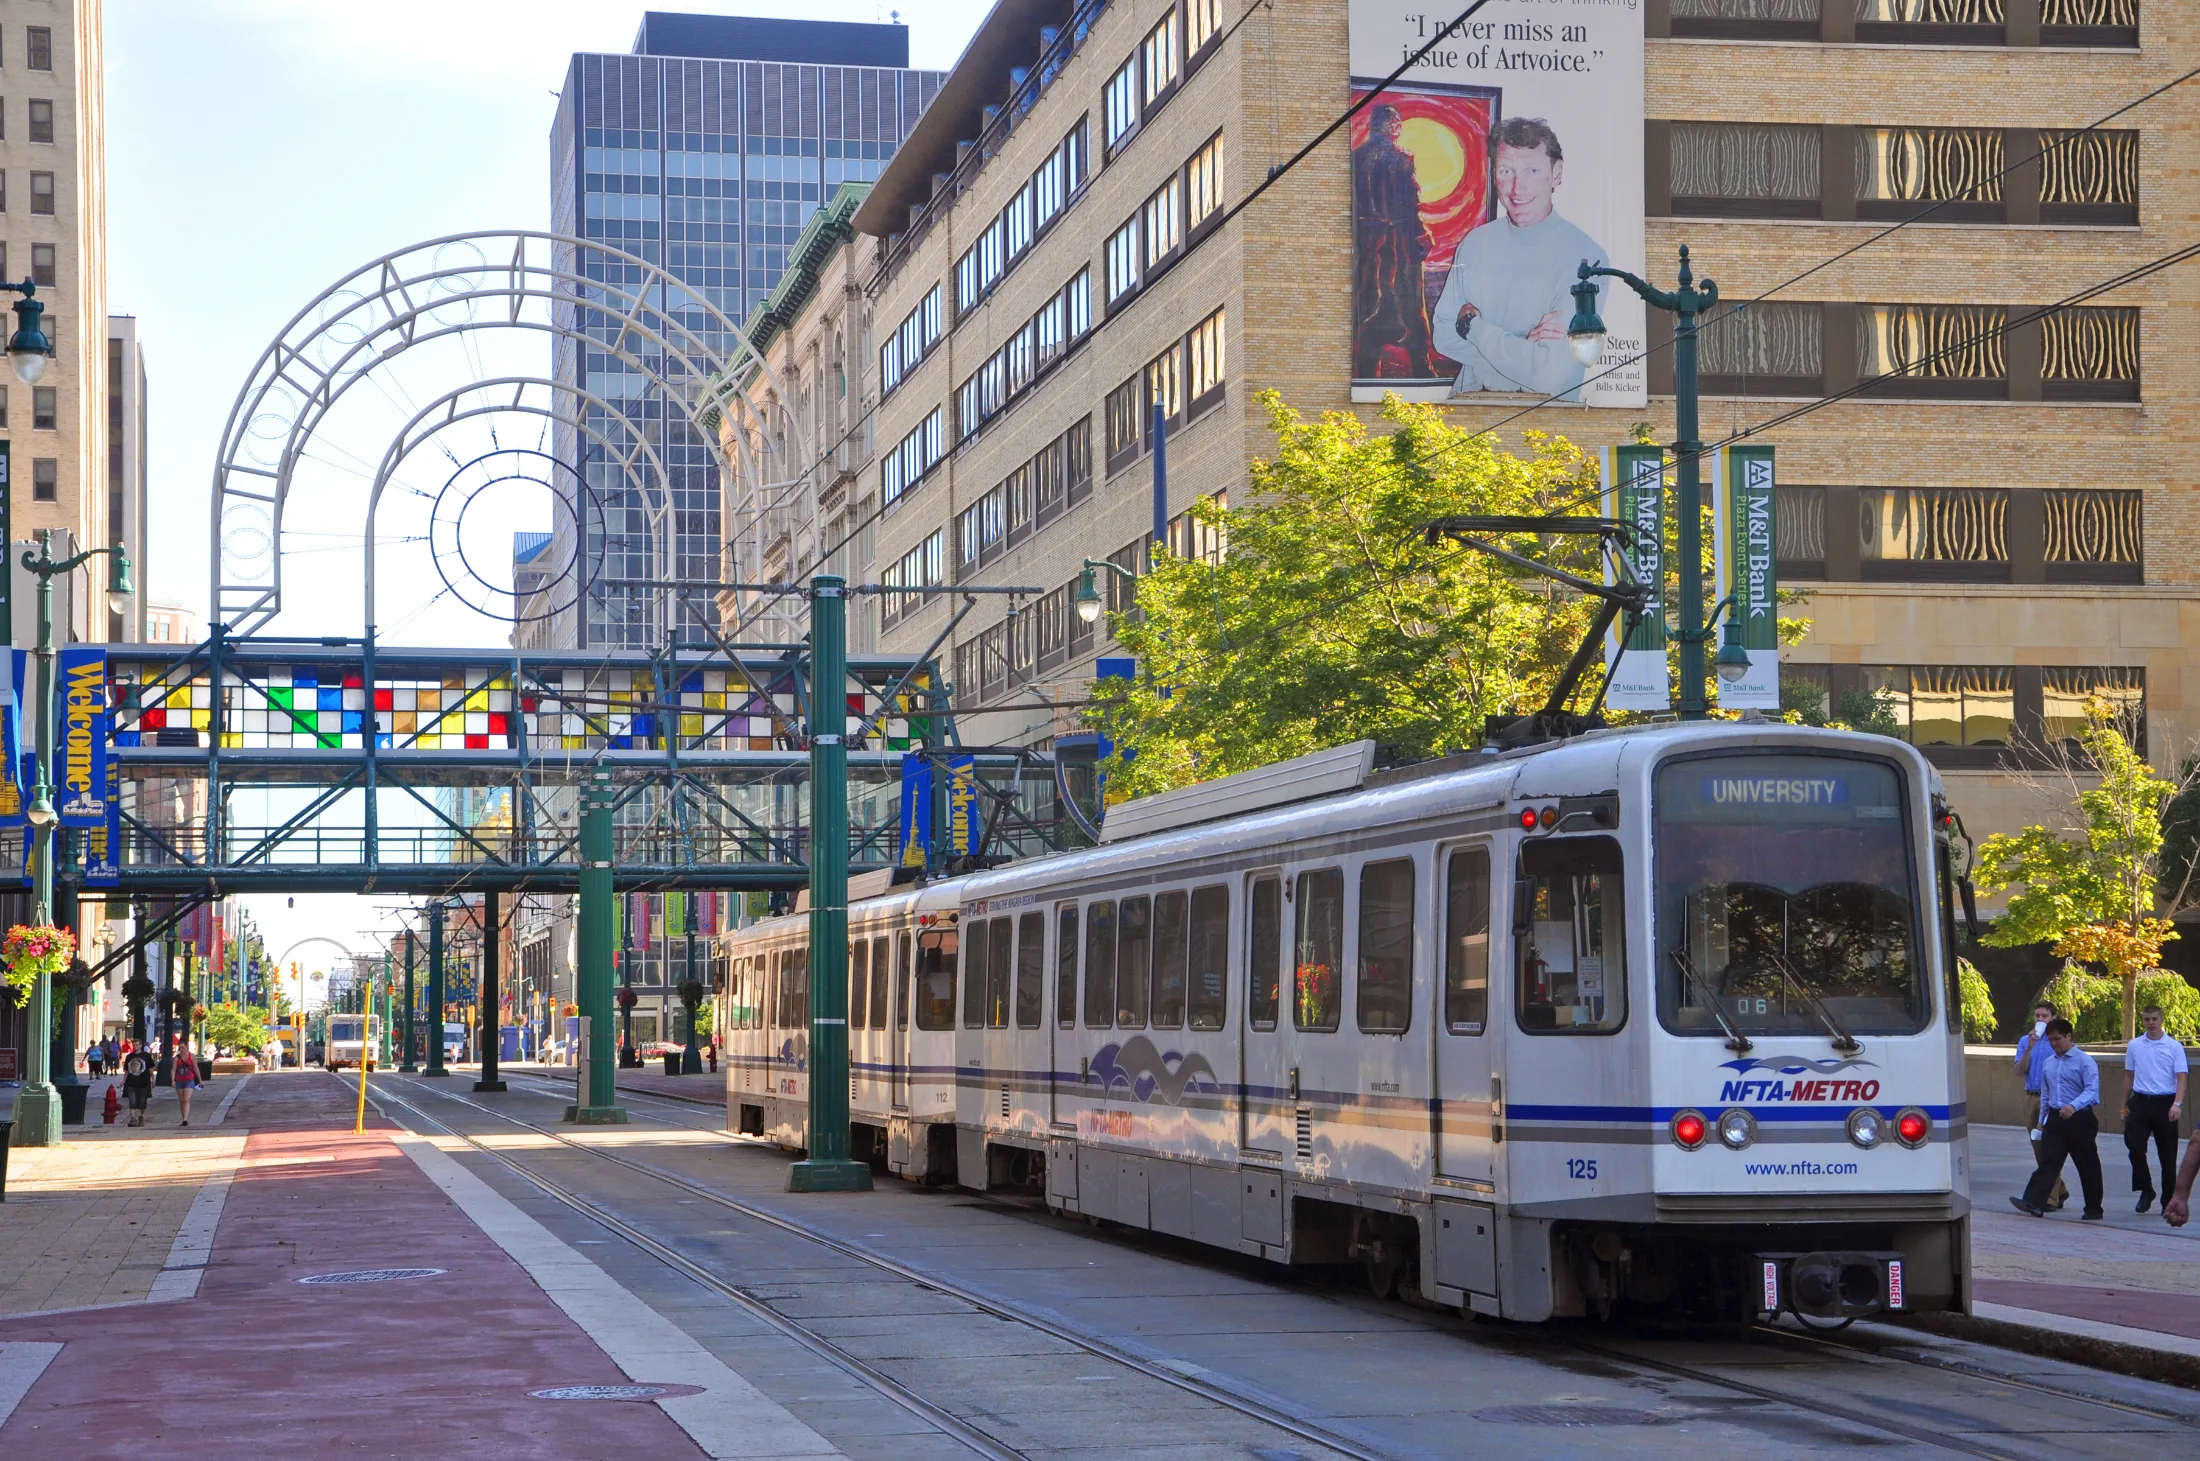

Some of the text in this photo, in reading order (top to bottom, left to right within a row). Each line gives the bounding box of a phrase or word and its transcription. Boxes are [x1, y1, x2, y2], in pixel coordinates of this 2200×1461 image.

[1434, 20, 1496, 40] never
[1503, 19, 1554, 42] miss
[1561, 25, 1588, 43] an
[1402, 44, 1458, 68] issue
[1466, 44, 1490, 69] of
[1607, 336, 1640, 350] Steve
[1596, 352, 1640, 366] hristie
[1602, 370, 1640, 380] Artist and
[1596, 382, 1641, 393] Bills Kicker
[1638, 495, 1661, 618] M&T Bak
[1736, 495, 1749, 608] Plaza Event Series
[1749, 495, 1772, 619] M&T Bank
[1622, 684, 1655, 692] M&T Bank
[1733, 684, 1765, 692] M&T Bank
[65, 659, 104, 792] Welcome
[1713, 779, 1836, 803] UNIVERSITY
[936, 1092, 948, 1103] 112
[1719, 1079, 1880, 1102] NFTA-METRO
[1566, 1158, 1598, 1180] 125
[1745, 1160, 1858, 1175] www.nfta.com
[1766, 1265, 1776, 1307] HIGH VOLTAGE
[1889, 1265, 1901, 1305] DANGER
